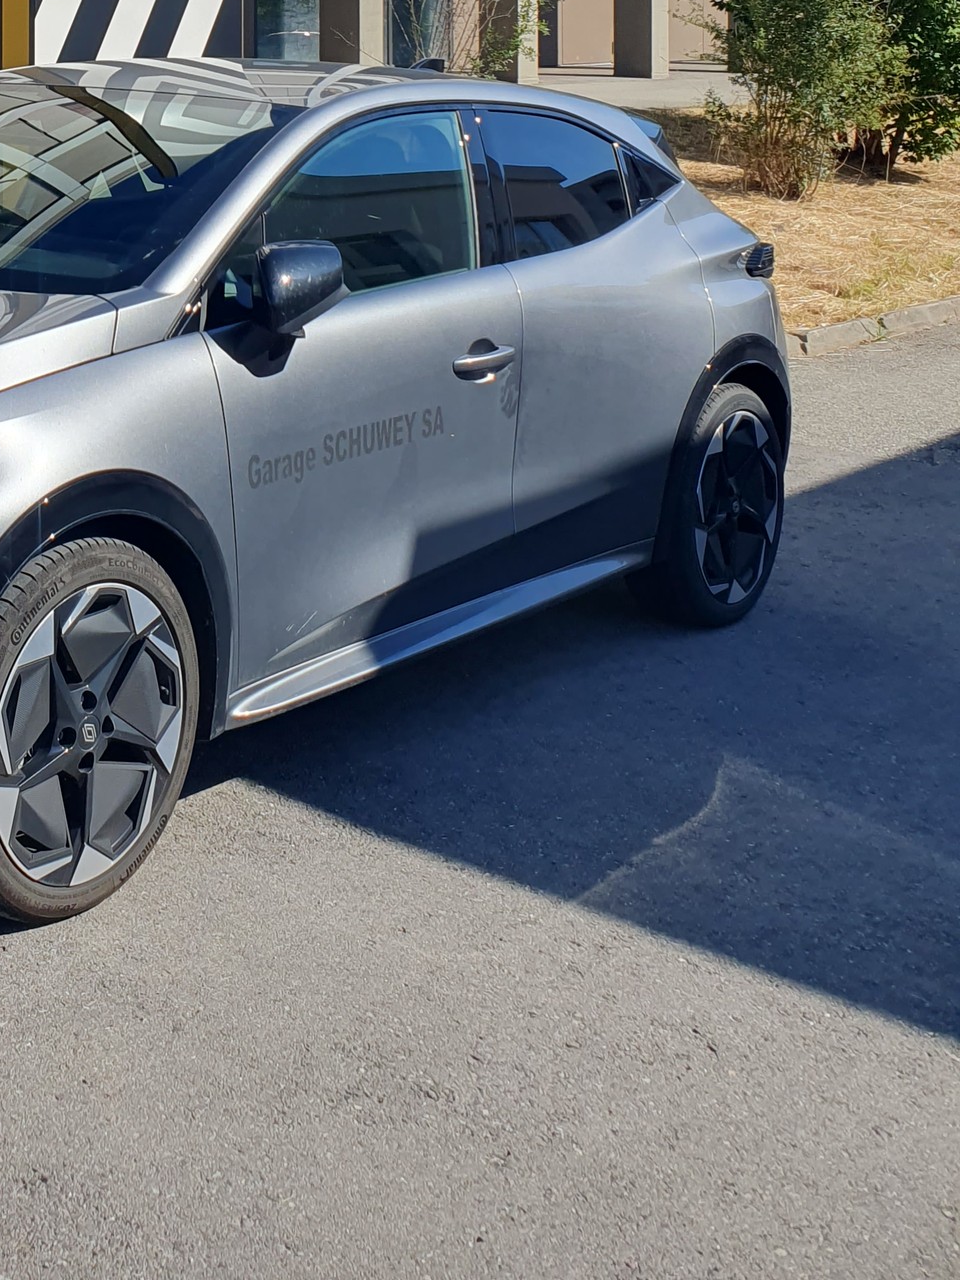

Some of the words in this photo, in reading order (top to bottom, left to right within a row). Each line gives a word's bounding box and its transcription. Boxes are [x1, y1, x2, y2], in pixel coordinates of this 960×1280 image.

[248, 446, 316, 489] Garage
[323, 411, 417, 466] SCHUWEY
[422, 406, 444, 439] SA
[10, 583, 60, 645] Continental
